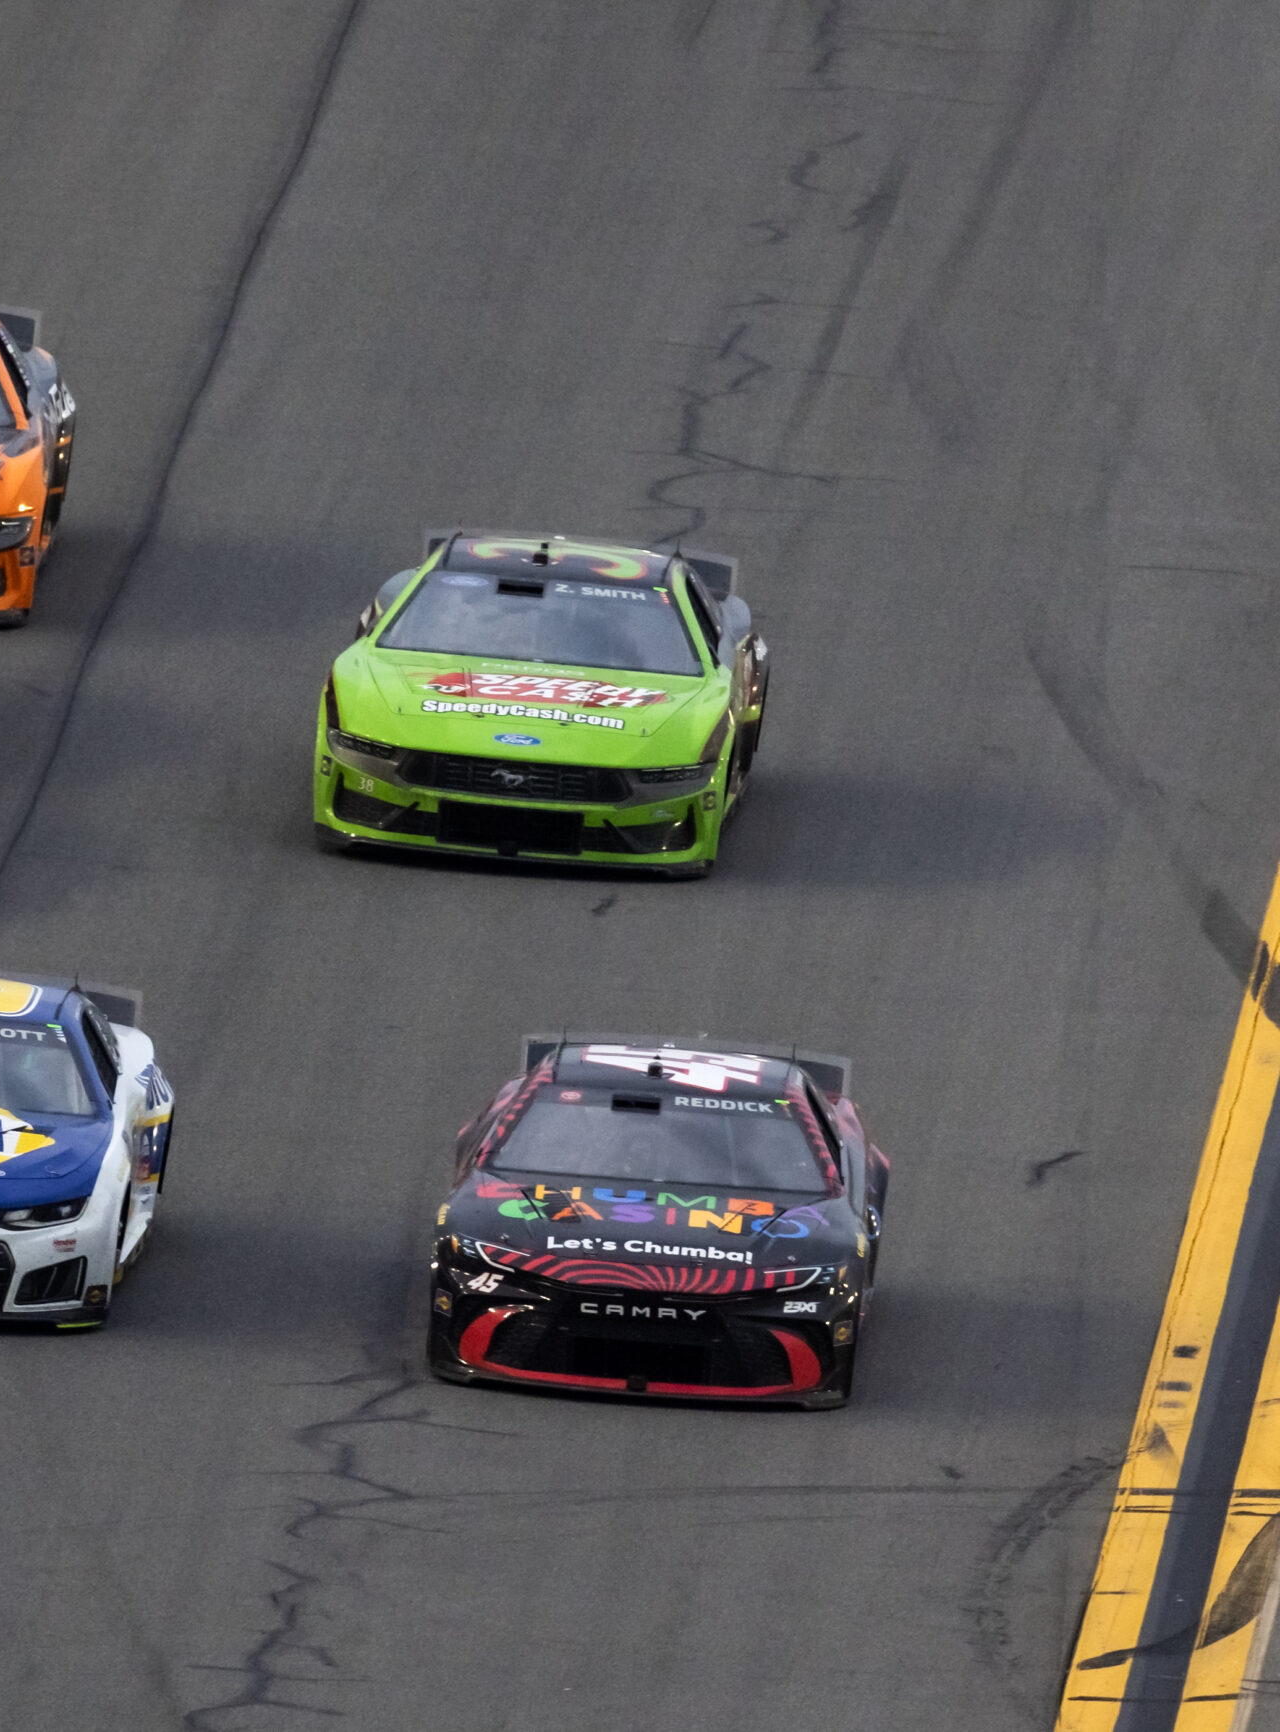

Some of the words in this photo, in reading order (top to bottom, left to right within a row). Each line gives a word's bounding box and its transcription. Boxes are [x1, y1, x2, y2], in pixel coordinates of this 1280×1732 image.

[555, 583, 576, 593] Z.
[581, 586, 646, 601] SMITH
[422, 699, 625, 730] SpeedyCash.com
[499, 734, 536, 745] Ford
[358, 776, 375, 793] 38
[674, 1096, 774, 1114] REDDICK
[476, 1182, 831, 1227] CHUMBA
[498, 1199, 810, 1239] CASINO
[547, 1236, 618, 1251] Let's
[624, 1239, 754, 1265] Chumba!
[466, 1272, 505, 1294] 45
[580, 1302, 706, 1321] CAMRY
